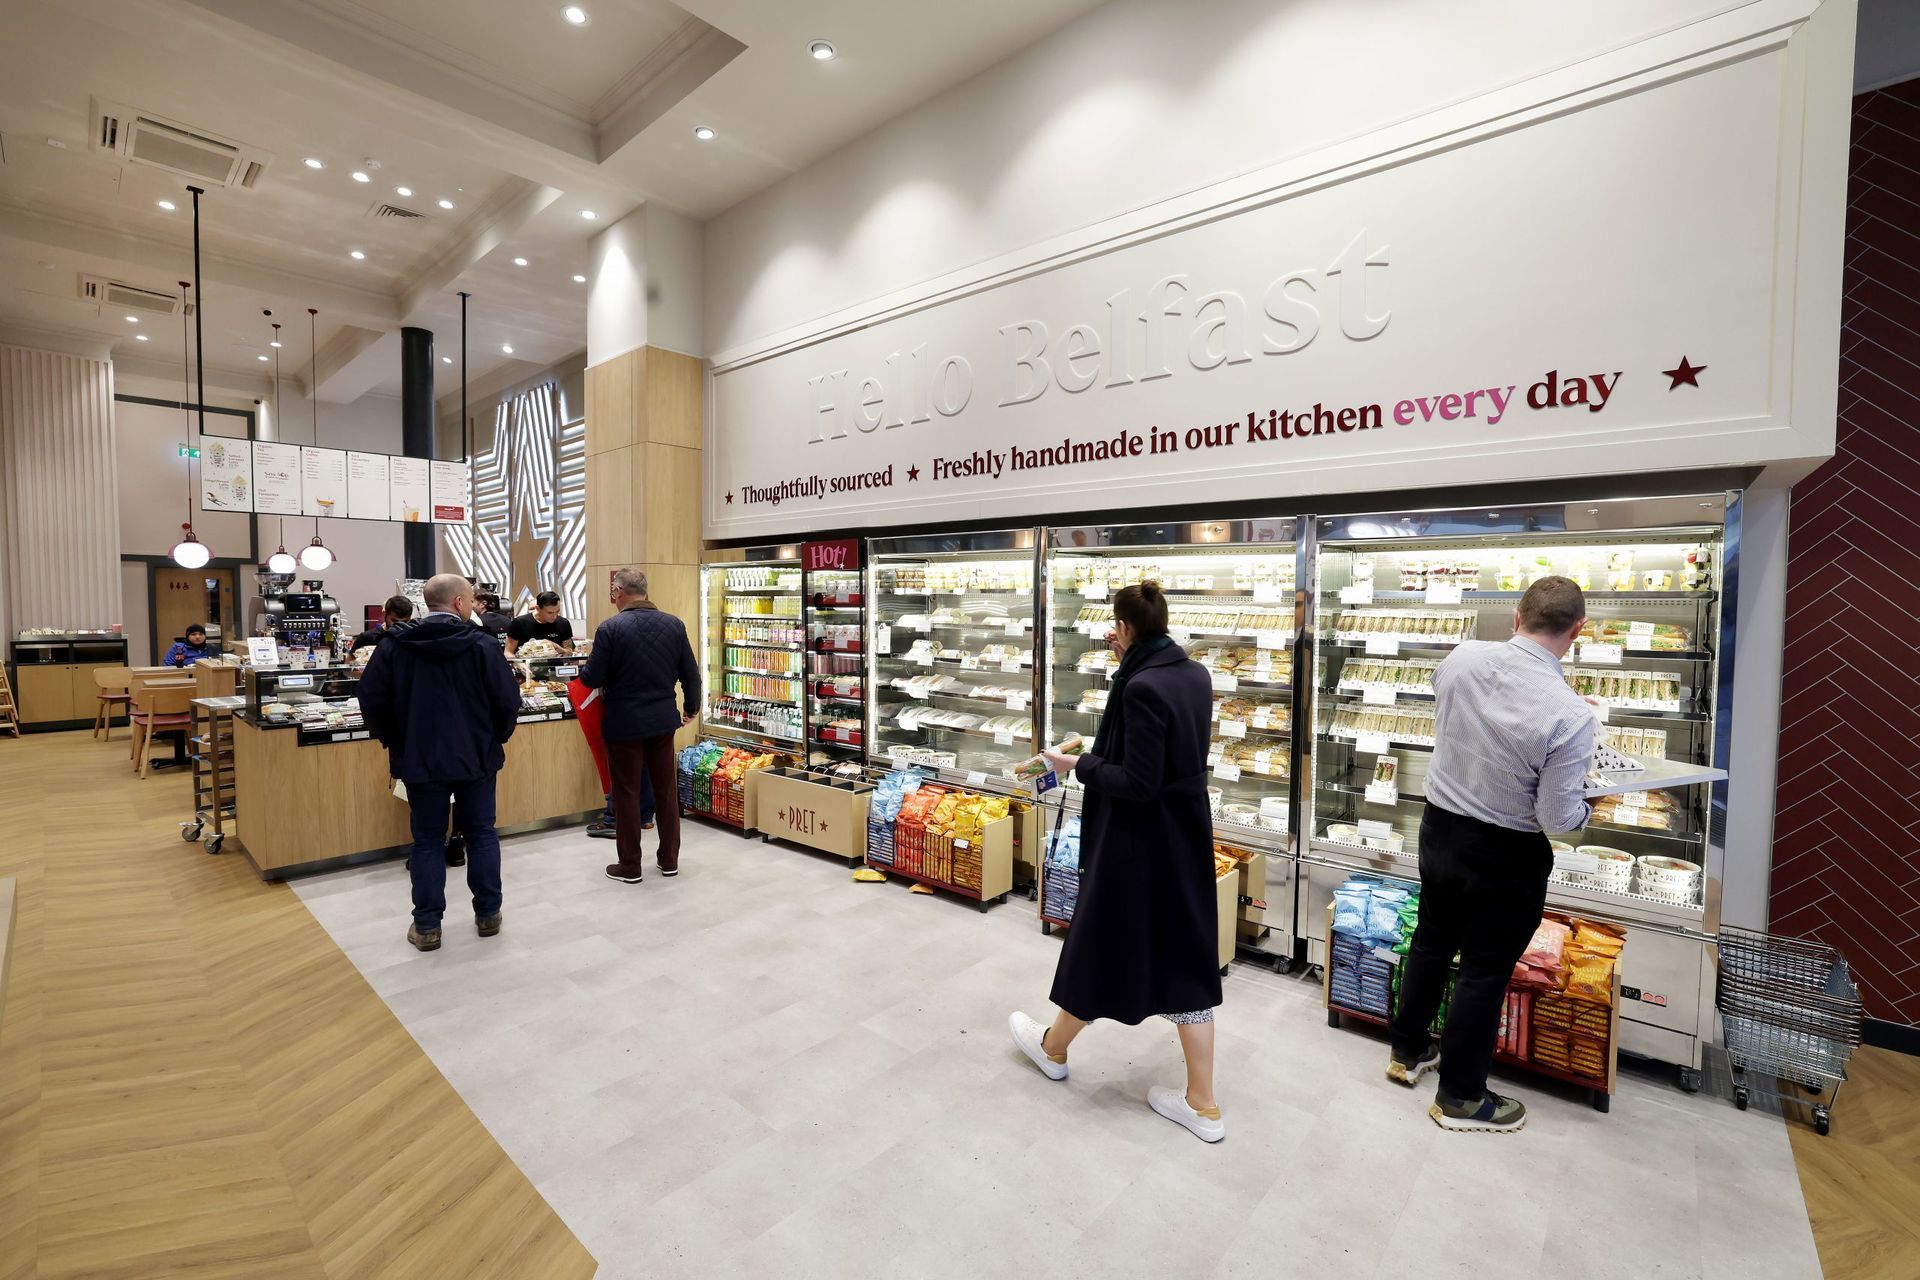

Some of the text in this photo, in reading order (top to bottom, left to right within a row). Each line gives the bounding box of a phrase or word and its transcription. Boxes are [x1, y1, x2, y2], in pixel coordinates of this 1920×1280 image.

[807, 226, 1392, 445] Hello Belfast
[741, 369, 1624, 505] Thoughtfully sourced Freshly handmade in our kitchen every day
[789, 806, 815, 835] PRET
[1593, 879, 1608, 888] PRET
[1660, 891, 1676, 900] PRET
